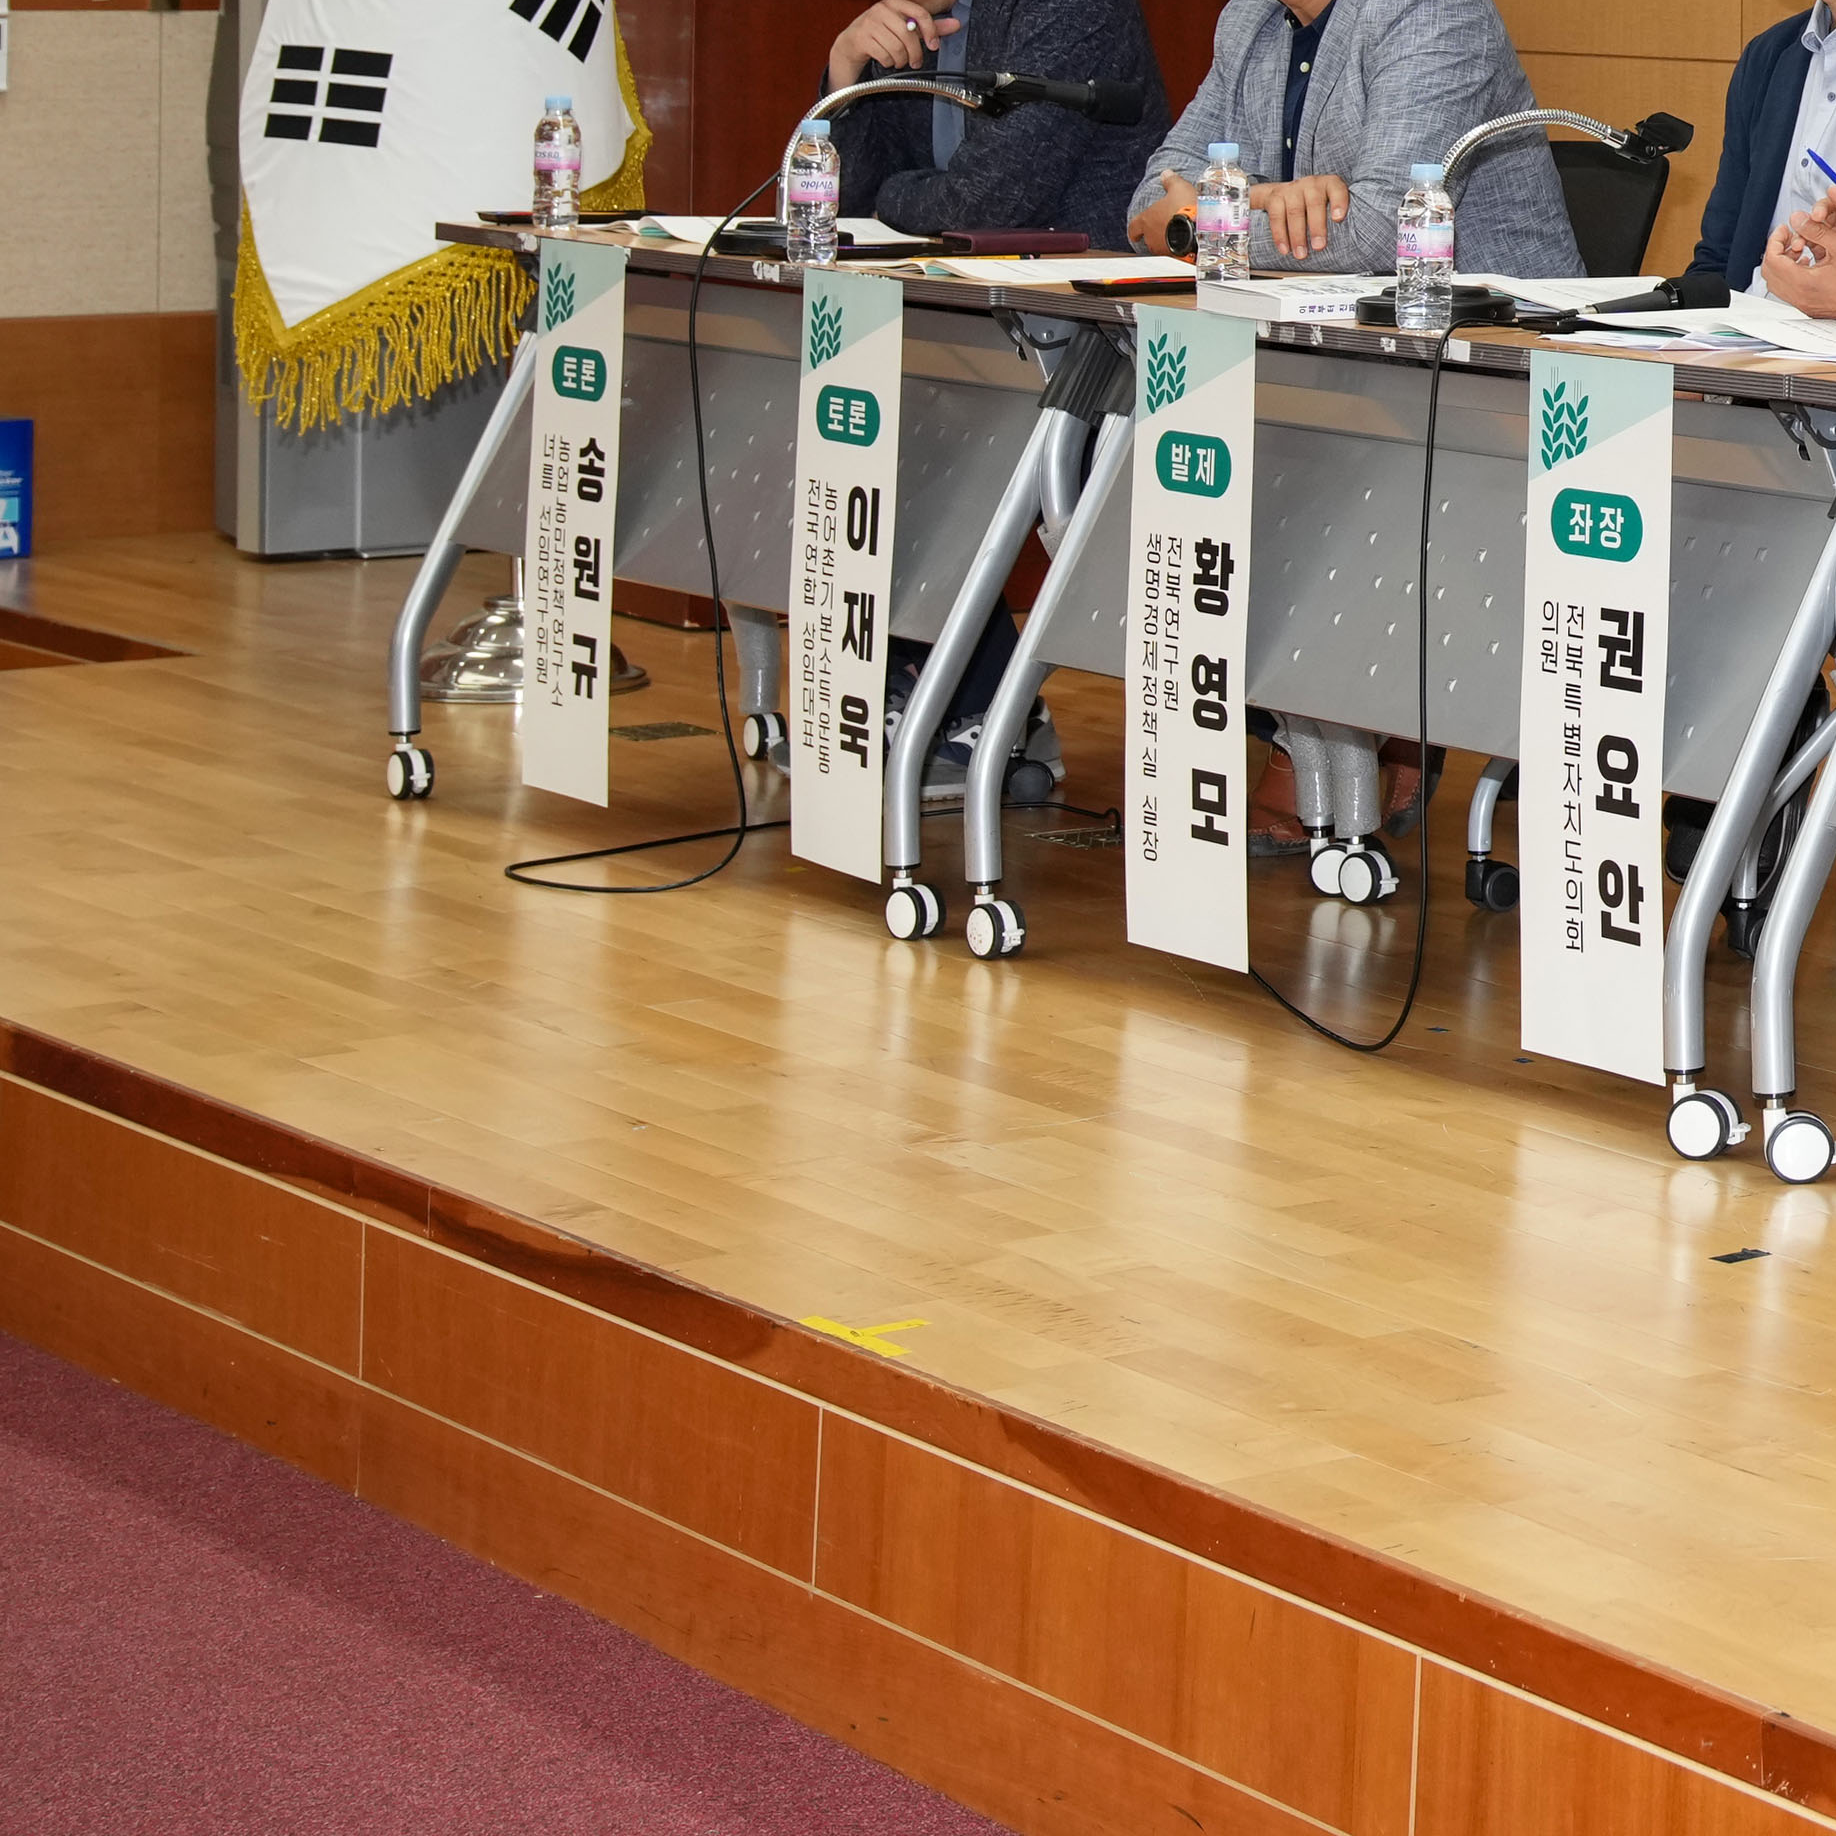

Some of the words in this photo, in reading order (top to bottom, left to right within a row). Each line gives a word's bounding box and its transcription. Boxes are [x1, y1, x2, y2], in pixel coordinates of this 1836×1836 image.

[563, 357, 595, 391] 토론
[828, 397, 866, 435] 토론
[542, 435, 554, 489] 녀름
[1172, 443, 1216, 486] 발제
[1569, 503, 1624, 548] 좌장
[536, 507, 550, 684] 선임연구위원
[571, 437, 606, 700] 송원규
[804, 479, 820, 605] 전국연합
[803, 623, 815, 748] 상임대표
[819, 483, 837, 773] 농어촌기본소득운동
[840, 486, 880, 768] 이재욱
[1143, 534, 1161, 778] 생명경제정책실
[1164, 537, 1182, 711] 전북연구원
[1191, 538, 1234, 846] 황영모
[1541, 601, 1559, 673] 의원
[1143, 796, 1158, 861] 실장
[1563, 605, 1584, 952] 전북특별자치도의회
[1596, 608, 1644, 946] 권요안
